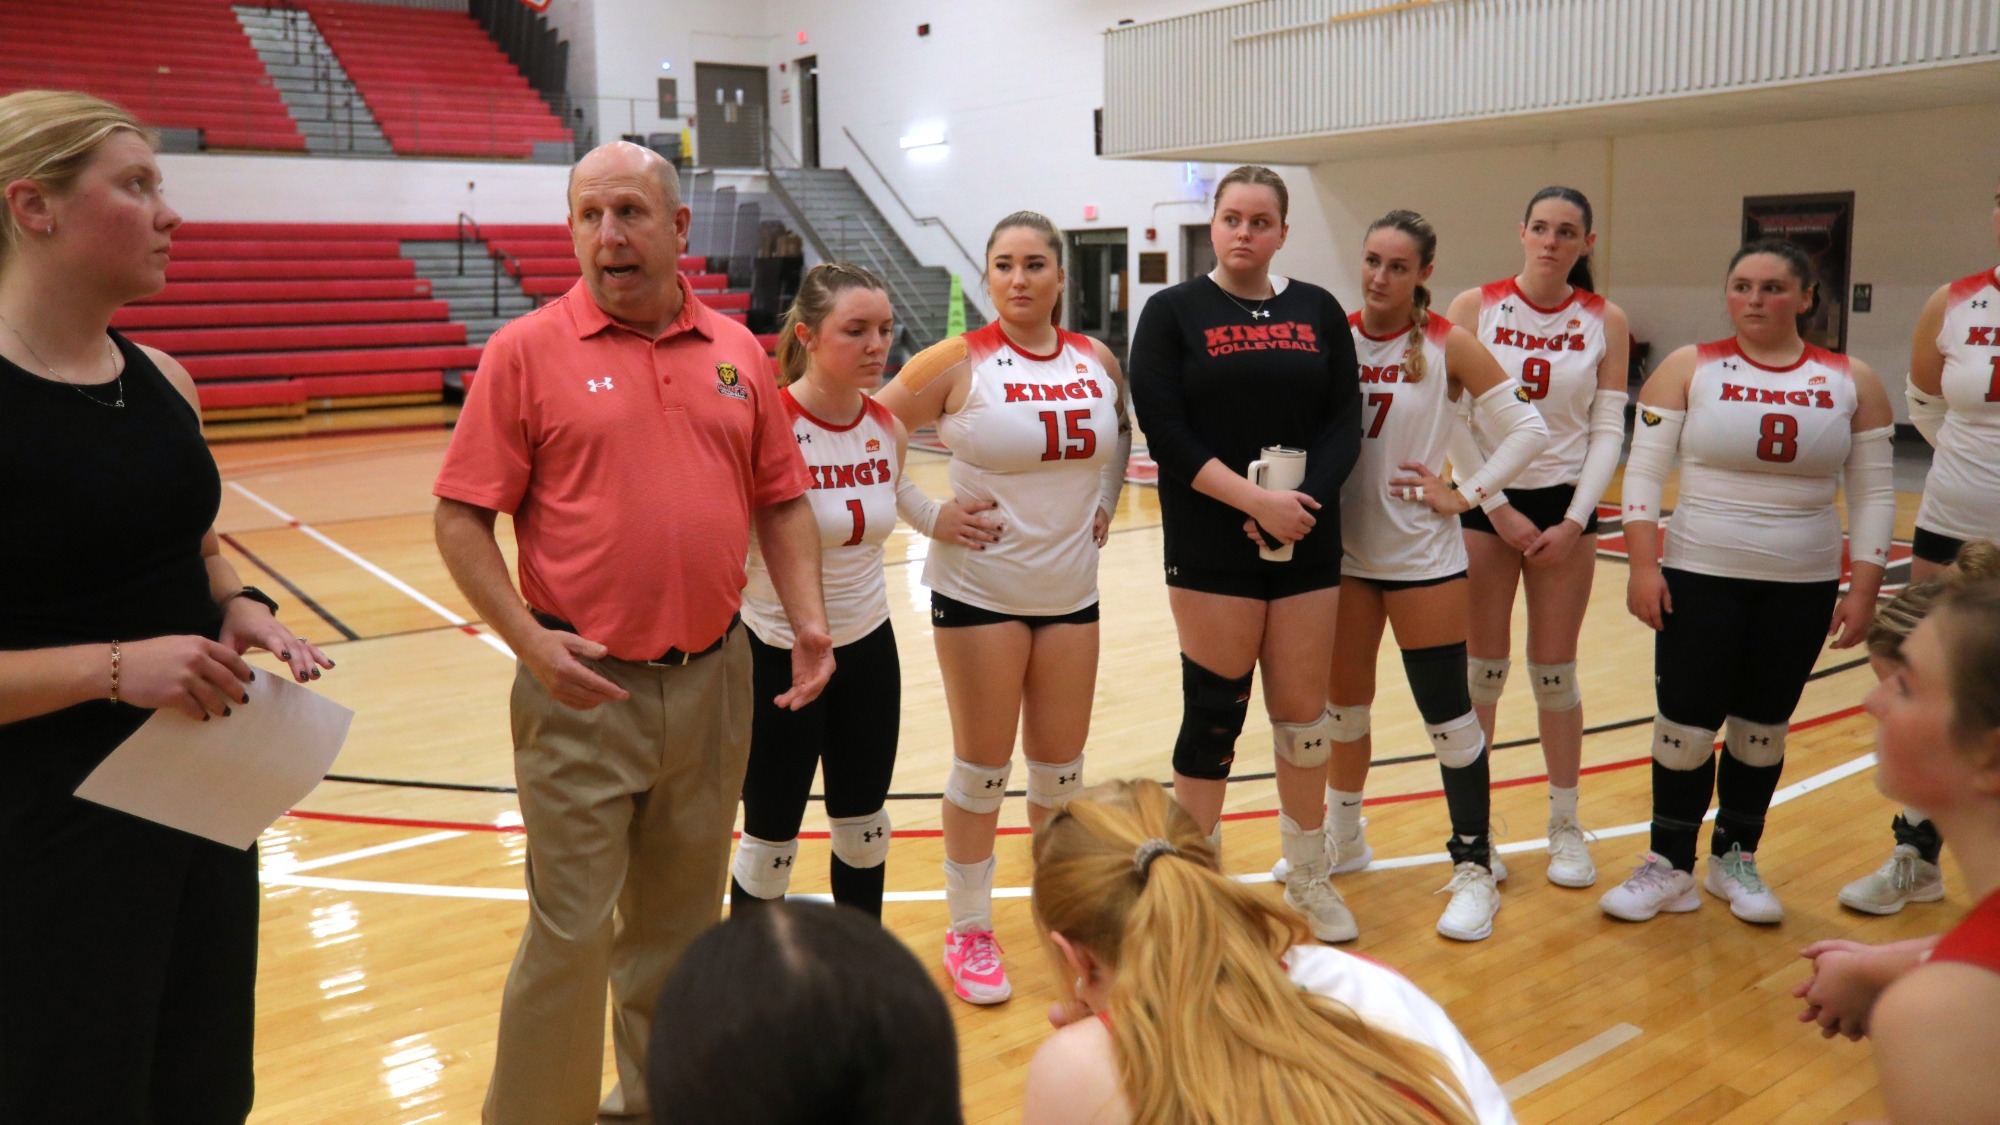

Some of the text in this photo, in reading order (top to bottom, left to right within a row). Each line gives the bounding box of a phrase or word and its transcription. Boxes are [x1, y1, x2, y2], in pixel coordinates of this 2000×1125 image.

[1204, 321, 1316, 348] KING'S
[1207, 340, 1320, 357] VOLLEYBALL
[1492, 326, 1585, 351] KING'S
[1004, 378, 1103, 403] KING'S
[1521, 357, 1551, 400] 9
[1719, 382, 1835, 409] KING'S
[1360, 393, 1393, 438] 7
[1039, 409, 1097, 462] 15
[1756, 412, 1798, 463] 8
[841, 499, 865, 546] 1
